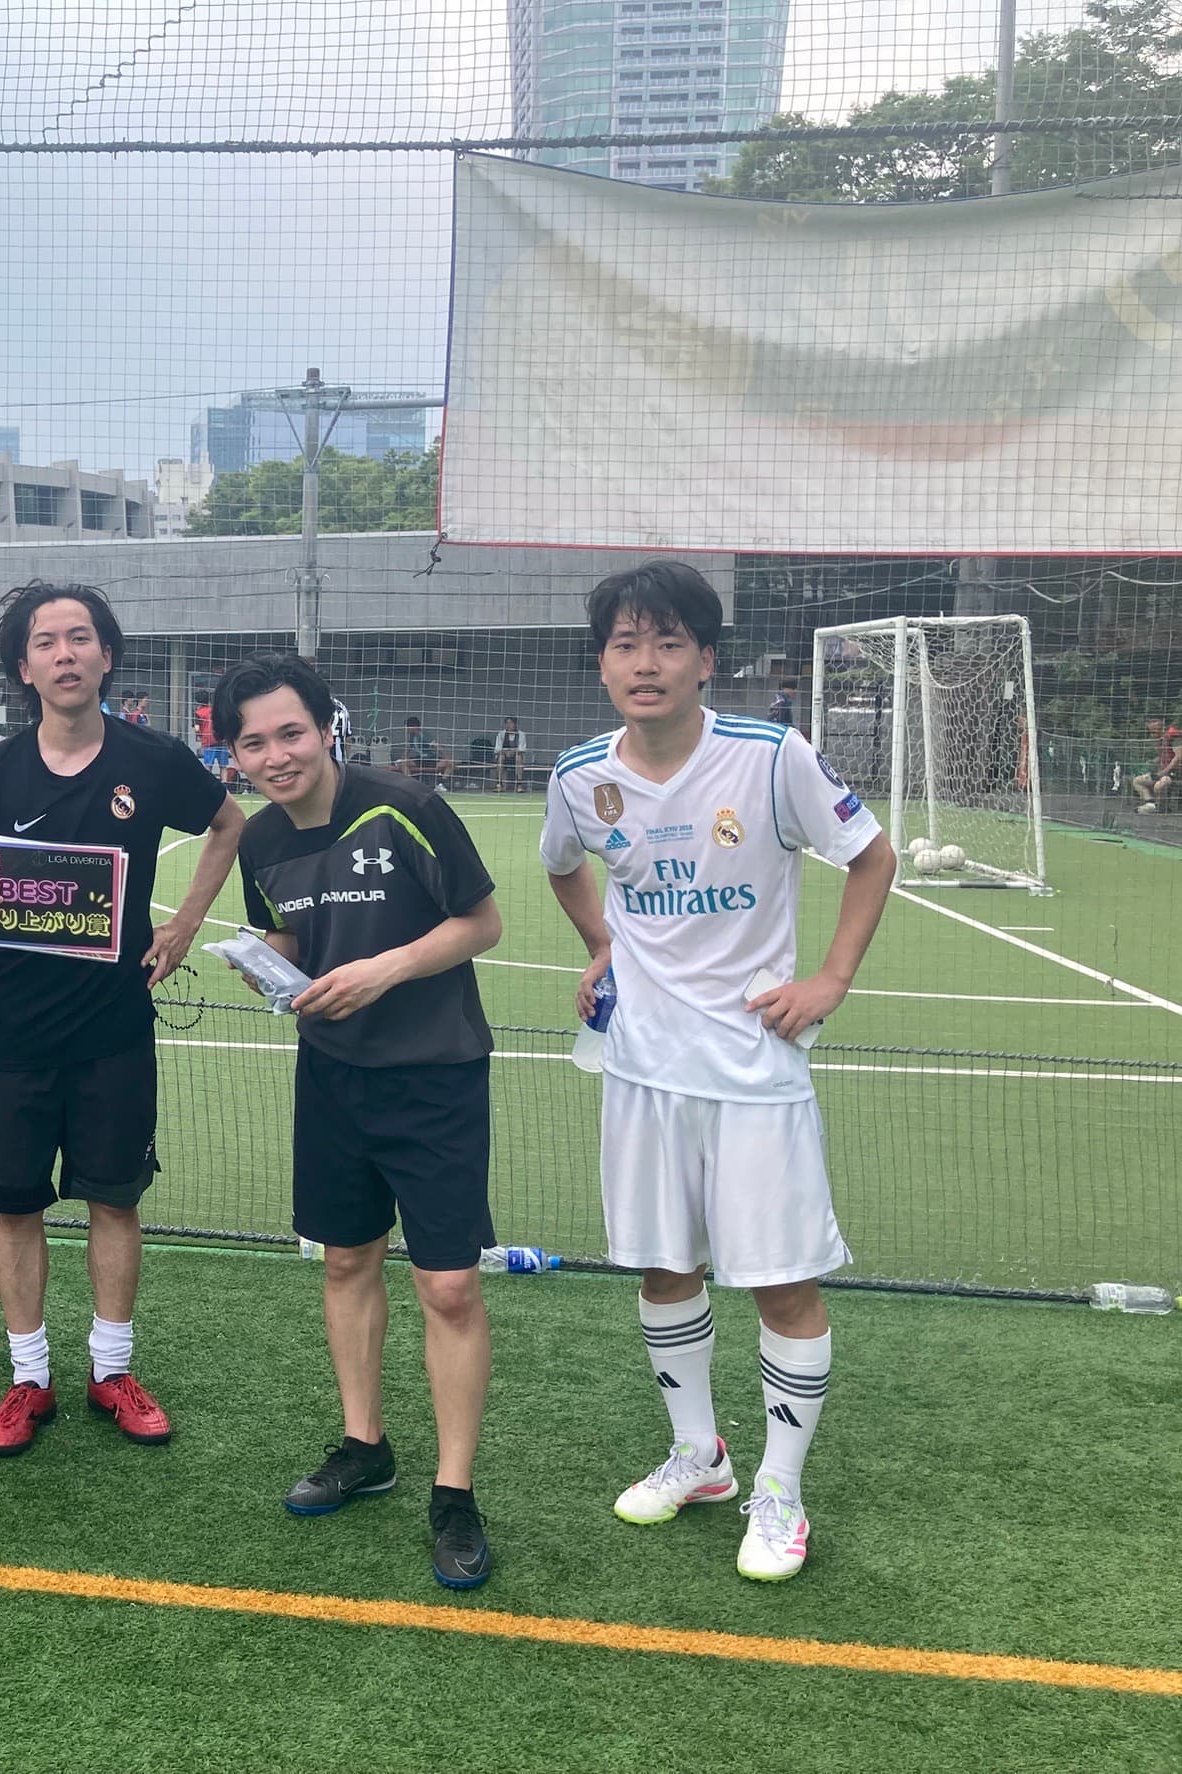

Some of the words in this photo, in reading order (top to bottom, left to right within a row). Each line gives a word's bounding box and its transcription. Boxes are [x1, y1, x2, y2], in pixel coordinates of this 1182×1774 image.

[48, 855, 68, 864] LIGA
[654, 859, 696, 883] Fly
[621, 883, 756, 915] Emirates
